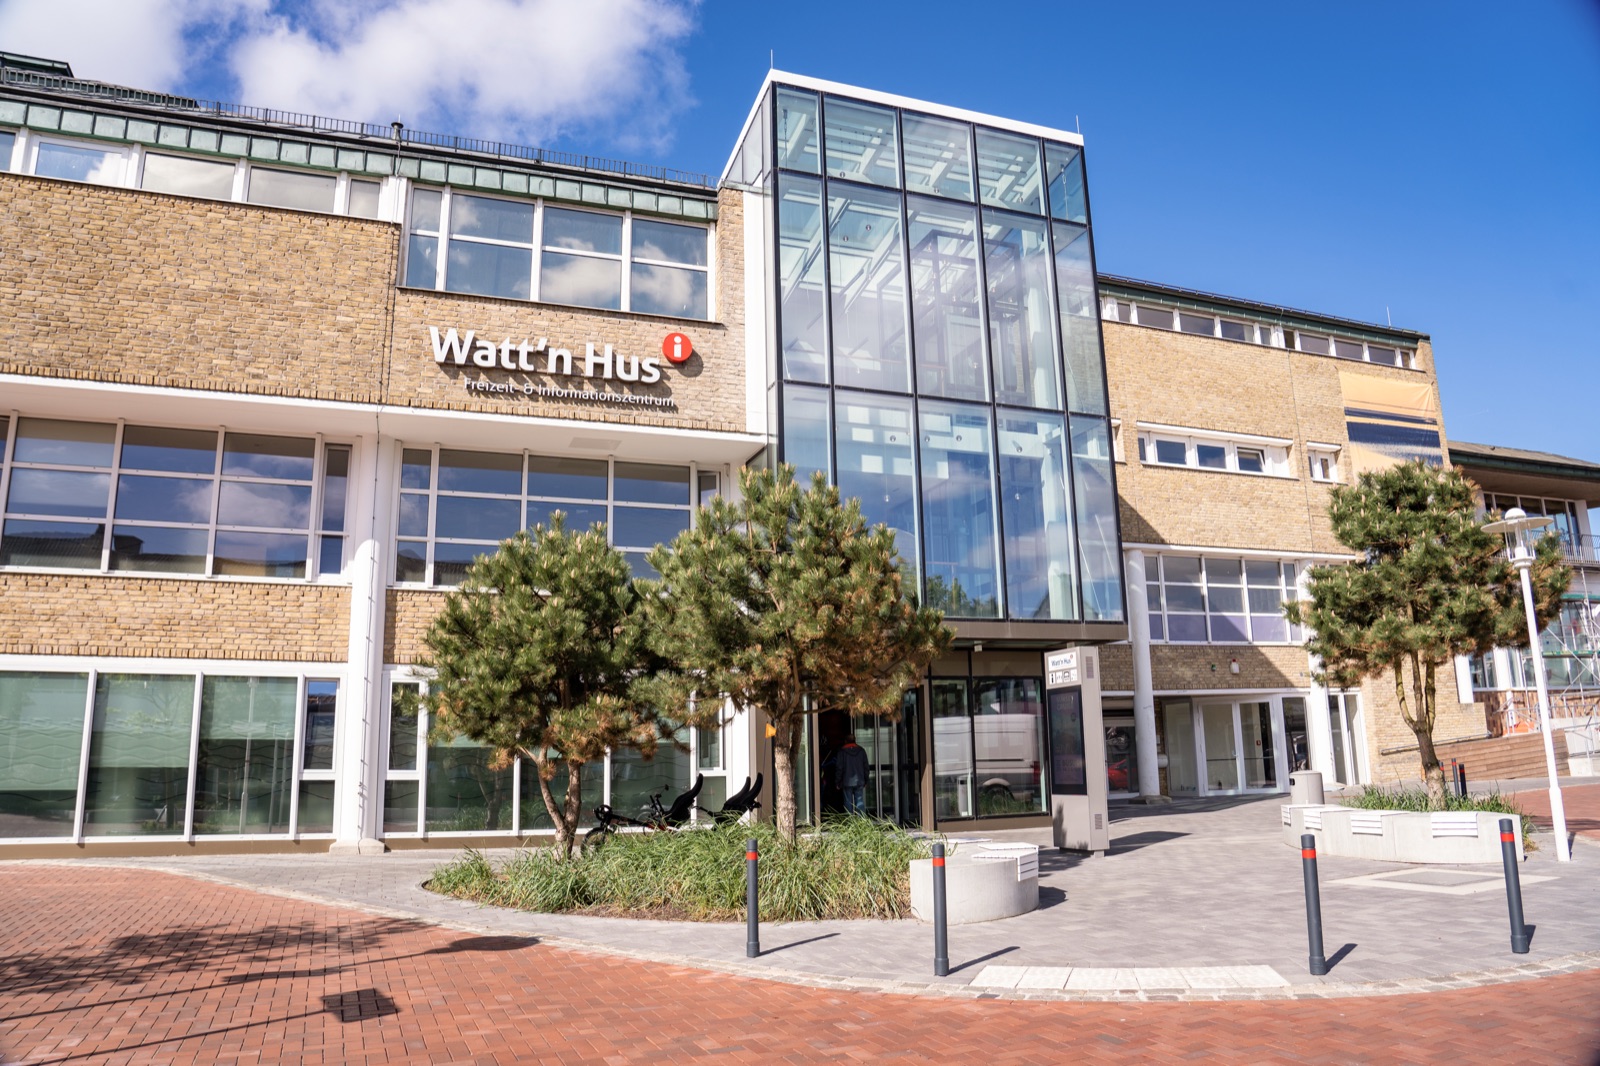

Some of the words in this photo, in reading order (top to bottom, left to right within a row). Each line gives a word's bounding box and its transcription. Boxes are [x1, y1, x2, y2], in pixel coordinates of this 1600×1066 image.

[429, 326, 572, 375] Watt'n
[585, 342, 661, 384] Hus
[464, 377, 519, 394] Freizeit-
[523, 383, 534, 395] &
[538, 384, 675, 407] Informationszentrum
